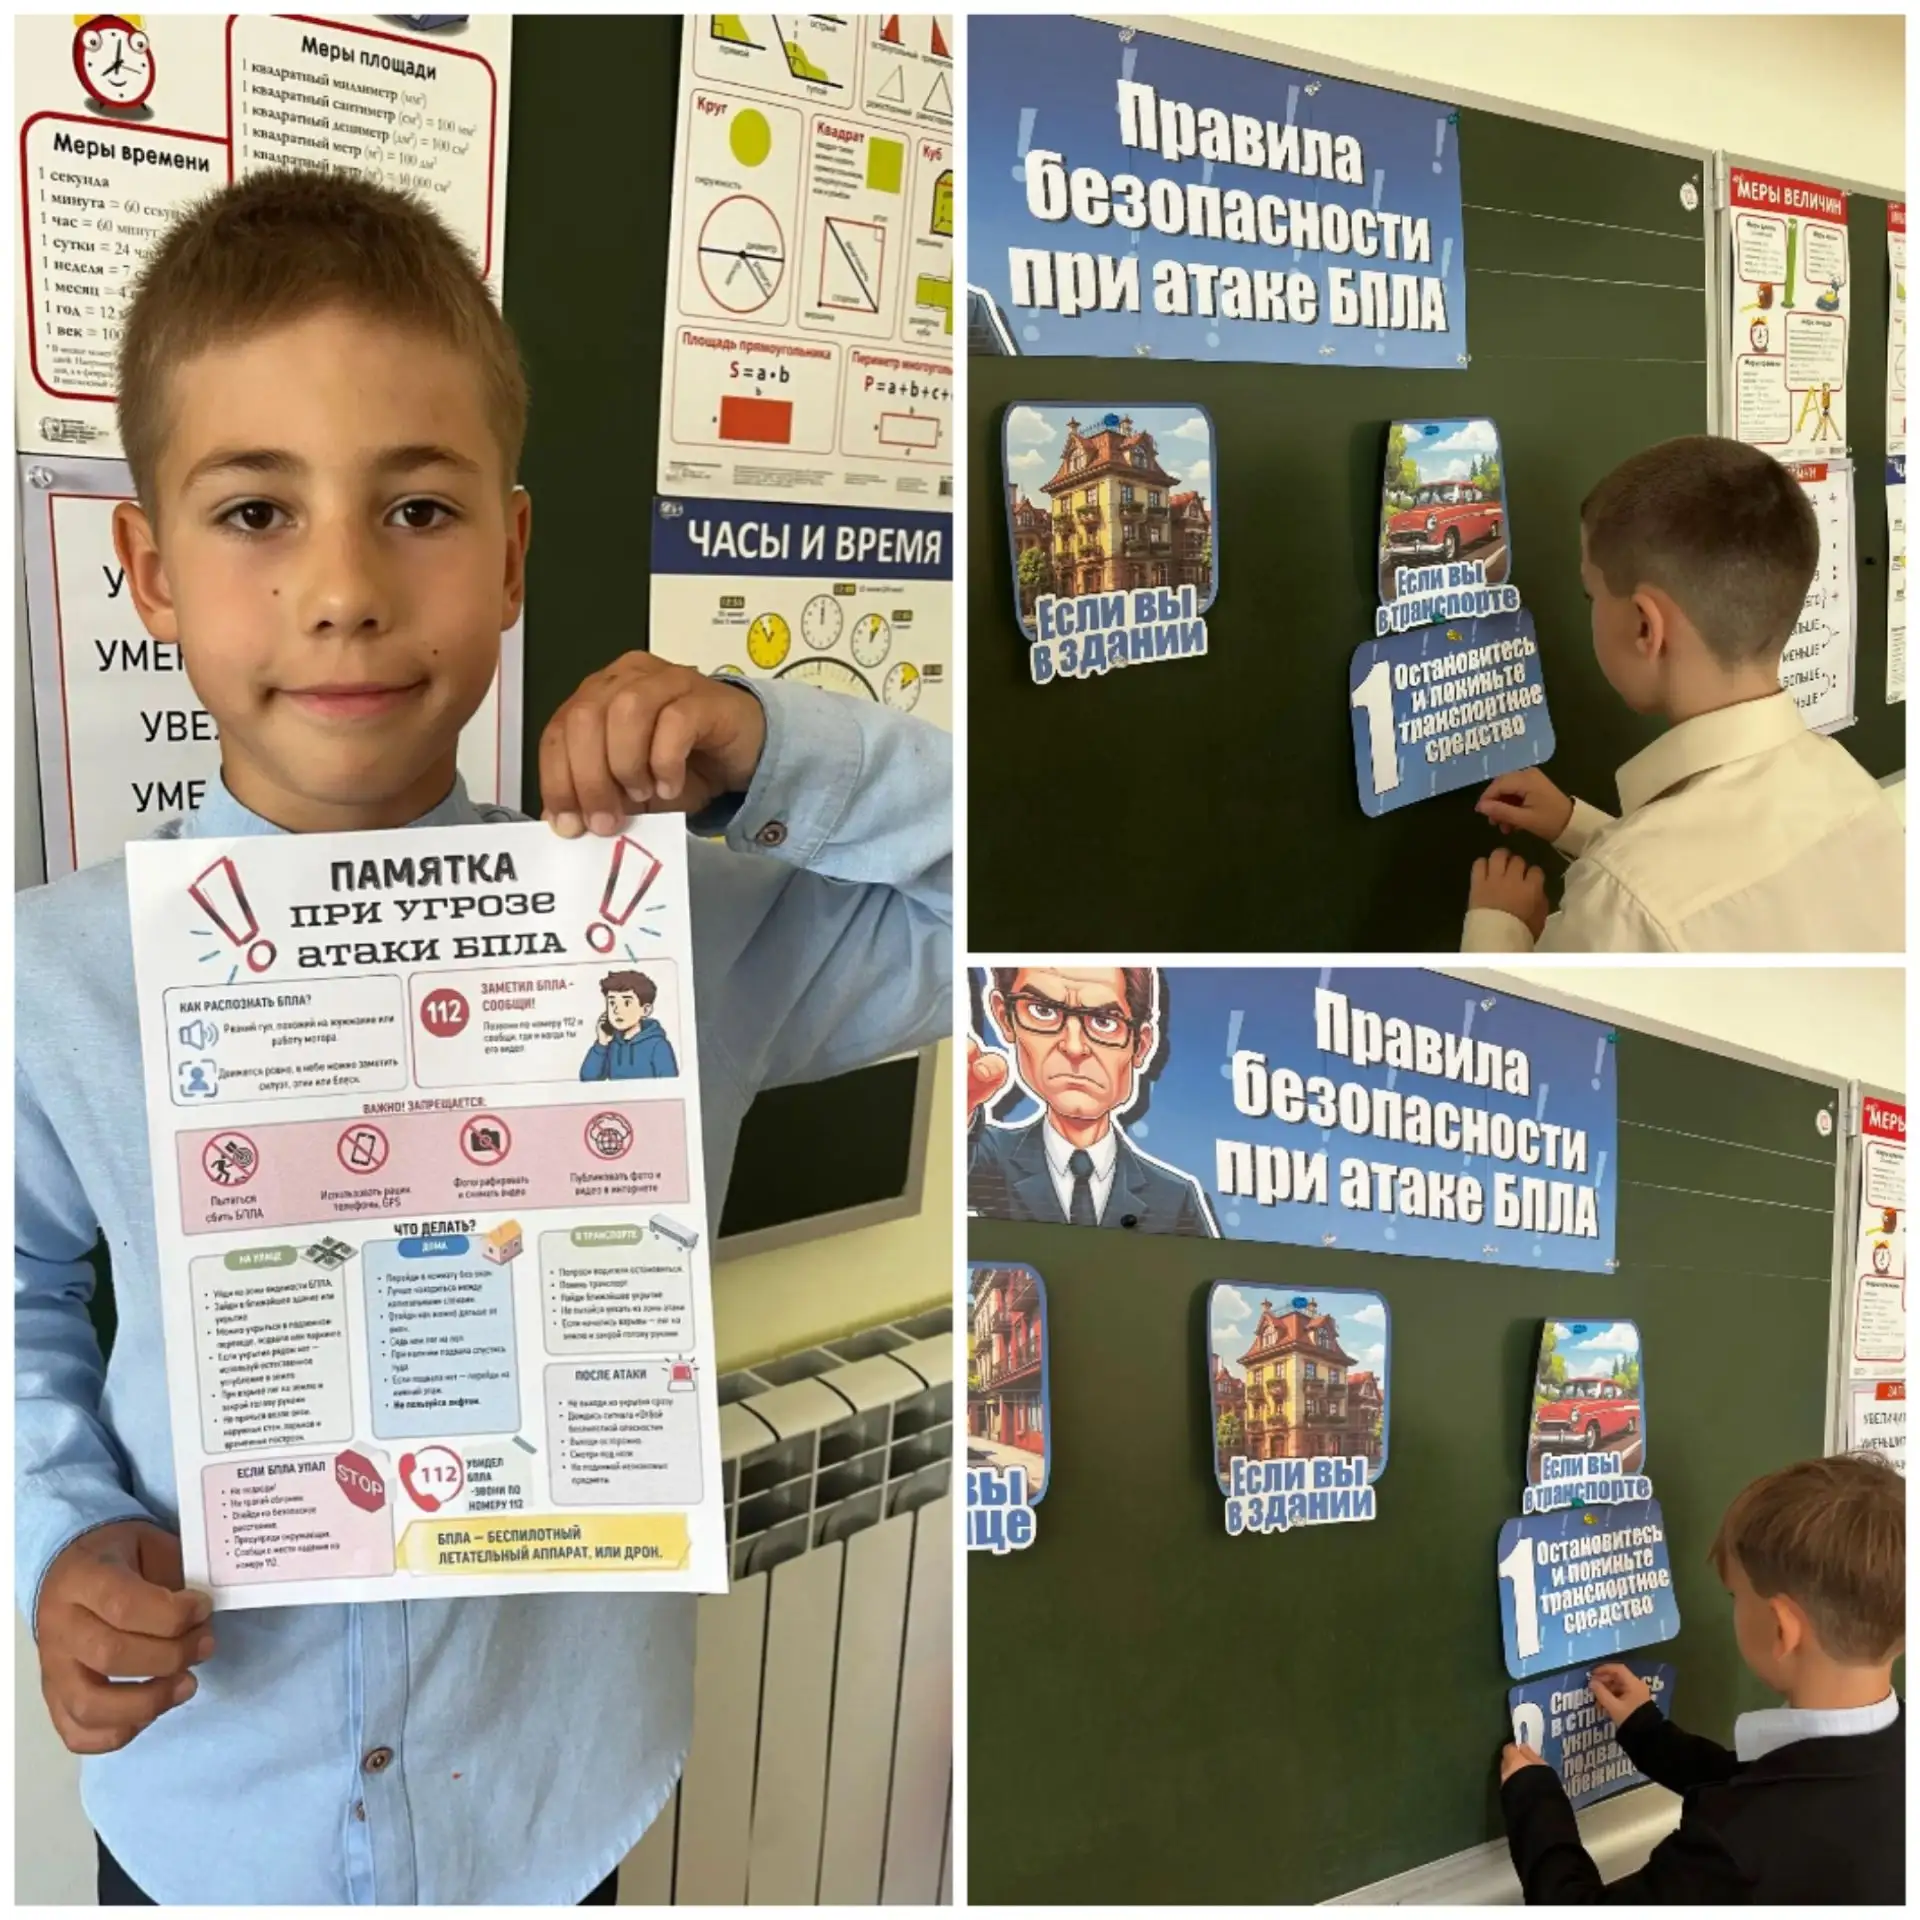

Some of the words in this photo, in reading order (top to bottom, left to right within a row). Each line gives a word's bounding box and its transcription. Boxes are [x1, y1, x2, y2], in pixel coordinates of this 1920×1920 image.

[301, 35, 355, 63] Меры
[360, 51, 437, 81] площади
[252, 63, 329, 86] квадратный
[252, 85, 329, 108] квадратный
[332, 100, 396, 124] сантиметр
[252, 106, 329, 129] квадратный
[696, 95, 728, 116] Круг
[252, 127, 329, 150] квадратный
[332, 142, 362, 159] метр
[816, 122, 865, 144] Квадрат
[1116, 78, 1365, 186] Правила
[53, 132, 116, 159] Меры
[122, 146, 210, 172] времени
[252, 149, 329, 172] квадратный
[922, 144, 943, 161] Куб
[50, 171, 110, 188] секунда
[694, 174, 743, 191] окружность
[51, 193, 105, 211] минута
[124, 200, 140, 214] 60
[1024, 149, 1432, 264] безопасности
[1737, 180, 1781, 204] МЕРЫ
[1783, 186, 1842, 215] ВЕЛИЧИН
[52, 214, 78, 228] час
[117, 223, 159, 240] минут
[53, 238, 95, 254] сутки
[114, 242, 130, 256] 24
[54, 260, 104, 276] неделя
[55, 282, 100, 297] месяц
[1008, 246, 1142, 317] при
[1152, 258, 1320, 325] атаке
[1328, 266, 1450, 333] БПЛА
[56, 305, 82, 318] год
[57, 326, 83, 338] век
[682, 331, 737, 350] Площадь
[739, 338, 832, 360] прямоугольника
[688, 519, 790, 560] ЧАСЫ
[801, 525, 825, 560] И
[835, 526, 942, 565] ВРЕМЯ
[1396, 566, 1446, 596] Если
[1449, 562, 1483, 586] вы
[1040, 596, 1126, 640] Если
[1134, 589, 1194, 621] вы
[1377, 608, 1389, 632] в
[1391, 588, 1518, 629] транспорте
[1034, 646, 1054, 682] в
[1058, 620, 1206, 675] здании
[1395, 636, 1536, 690] Остановитесь
[1411, 689, 1427, 715] и
[1429, 663, 1526, 709] покиньте
[1398, 683, 1543, 744] транспортное
[1351, 659, 1400, 796] 1
[1424, 714, 1527, 764] средство
[330, 852, 518, 892] ПАМЯТКА
[290, 899, 382, 928] ПРИ
[453, 931, 567, 960] БПЛА
[481, 980, 534, 996] ЗАМЕТИЛ
[536, 979, 567, 992] БПЛА
[179, 1002, 202, 1013] КАК
[204, 997, 275, 1012] РАСПОЗНАТЬ
[277, 994, 312, 1008] БПЛА?
[426, 998, 463, 1026] 112
[482, 998, 536, 1013] СООБЩИ!
[1313, 986, 1530, 1097] Правила
[363, 1101, 405, 1114] ВАЖНО!
[1230, 1049, 1588, 1174] безопасности
[452, 1176, 530, 1189] Фотографировать
[569, 1171, 628, 1183] Публиковать
[1215, 1138, 1328, 1207] при
[1340, 1156, 1484, 1225] атаке
[1493, 1171, 1599, 1239] БПЛА
[210, 1195, 257, 1208] Пытаться
[320, 1189, 382, 1201] Использовать
[235, 1208, 264, 1220] БПЛА
[394, 1223, 418, 1236] ЧТО
[421, 1219, 477, 1237] ДЕЛАТЬ?
[583, 1230, 638, 1240] ТРАНСПОРТЕ
[422, 1242, 448, 1253] ДОМА
[574, 1370, 611, 1381] ПОСЛЕ
[612, 1369, 647, 1380] АТАКИ
[237, 1466, 266, 1479] ЕСЛИ
[267, 1463, 295, 1475] БПЛА
[297, 1461, 326, 1473] УПАЛ
[421, 1465, 457, 1485] 112
[466, 1457, 504, 1470] УВИДЕЛ
[1543, 1456, 1583, 1480] Если
[1587, 1454, 1619, 1475] вы
[336, 1463, 384, 1497] STOP
[466, 1472, 492, 1483] БПЛА
[508, 1485, 521, 1495] ПО
[1233, 1459, 1305, 1497] Если
[1312, 1459, 1366, 1487] вы
[468, 1499, 507, 1512] НОМЕРУ
[508, 1499, 524, 1509] 112
[1525, 1491, 1532, 1511] в
[1535, 1478, 1650, 1508] транспорте
[1229, 1502, 1242, 1533] в
[1248, 1488, 1373, 1531] здании
[437, 1532, 471, 1546] БПЛА
[486, 1525, 582, 1543] БЕСПИЛОТНЫЙ
[1537, 1525, 1663, 1565] Остановитесь
[438, 1548, 530, 1565] ЛЕТАТЕЛЬНЫЙ
[532, 1547, 593, 1561] АППАРАТ,
[595, 1547, 621, 1558] ИЛИ
[623, 1547, 663, 1561] ДРОН.
[1552, 1567, 1564, 1587] и
[1567, 1549, 1654, 1584] покиньте
[1498, 1537, 1541, 1660] 1
[1540, 1569, 1670, 1615] транспортное
[1564, 1595, 1654, 1634] средство
[1552, 1718, 1562, 1738] в
